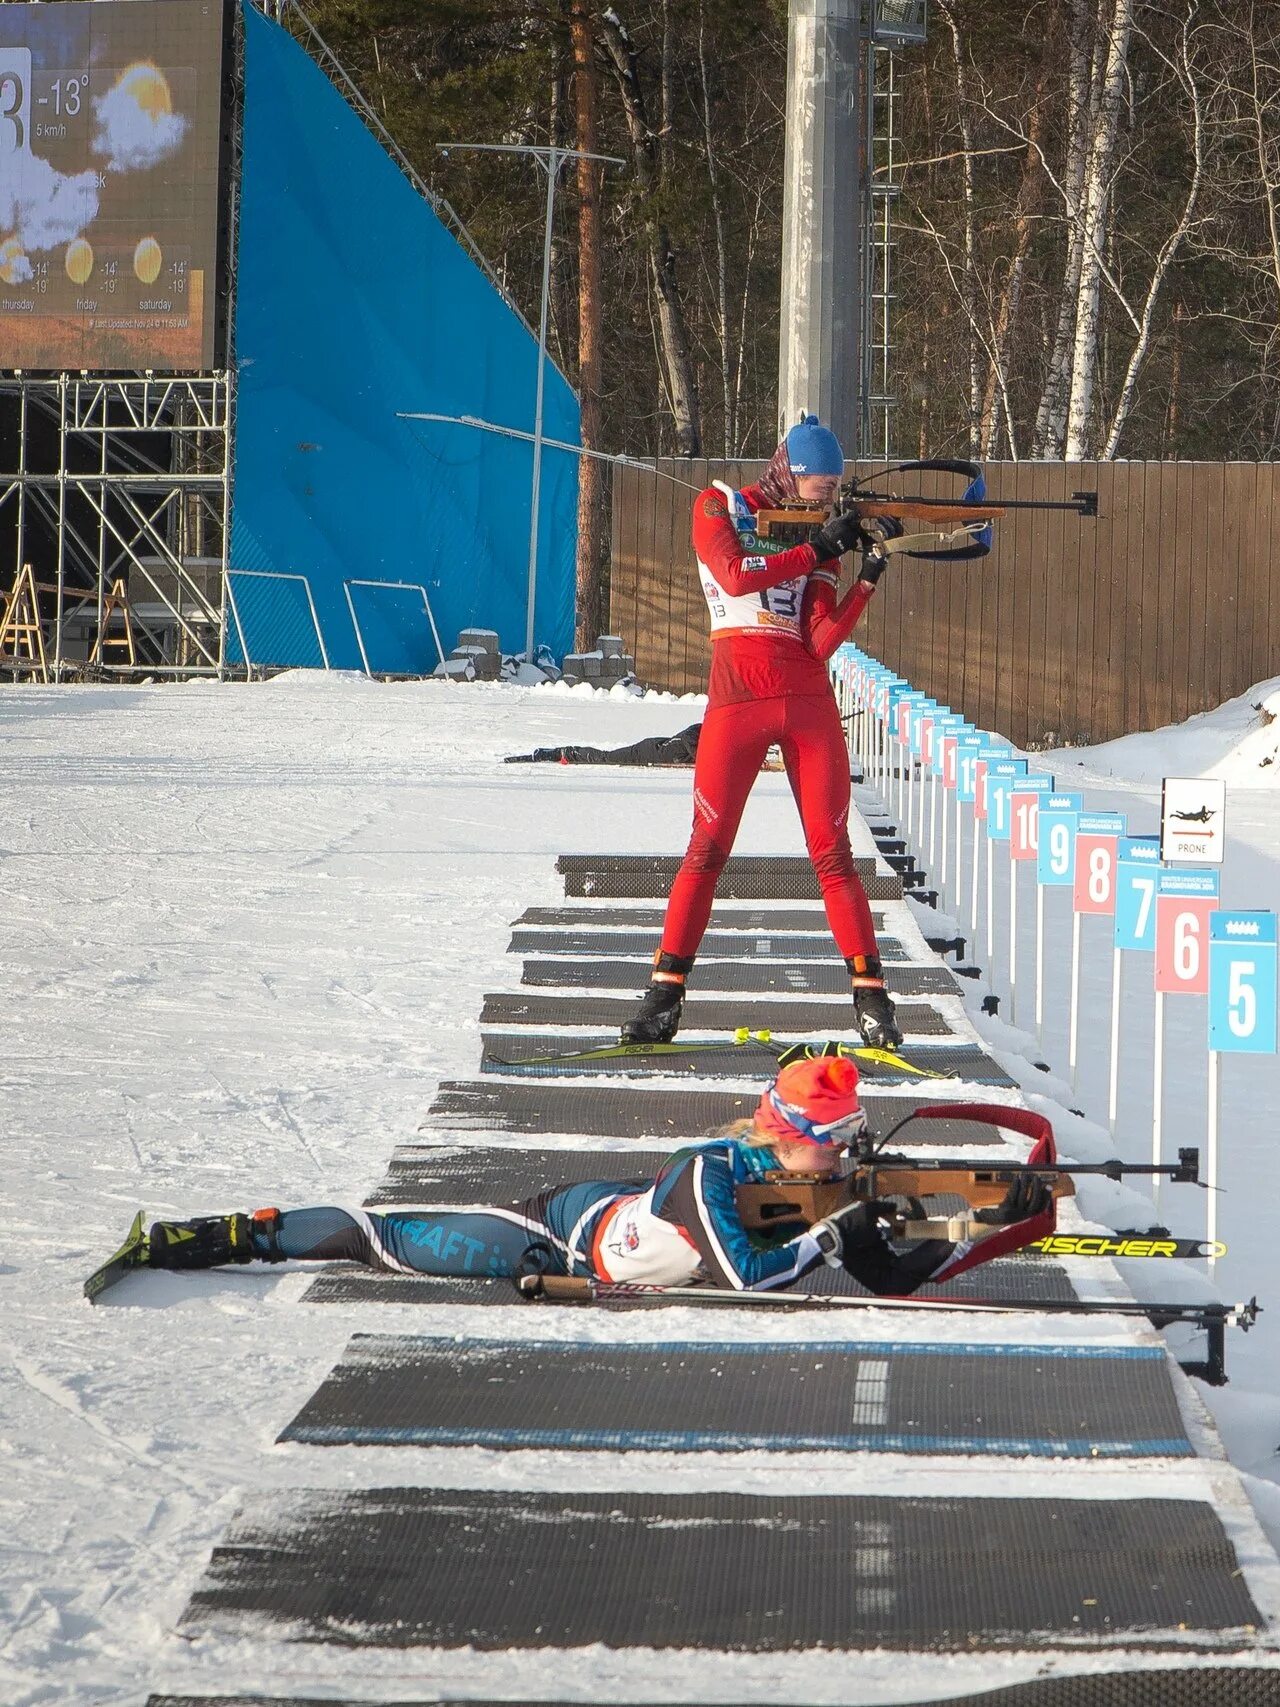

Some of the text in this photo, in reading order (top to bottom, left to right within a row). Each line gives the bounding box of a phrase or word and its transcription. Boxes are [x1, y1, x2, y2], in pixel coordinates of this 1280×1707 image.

[38, 74, 89, 115] -13°
[36, 123, 67, 136] 5 km/h
[76, 300, 98, 312] friday
[139, 300, 172, 312] saturday
[712, 604, 726, 618] 13
[1050, 824, 1069, 875] 9
[1178, 843, 1207, 854] PRONE
[1089, 847, 1111, 903] 8
[1131, 878, 1155, 938] 7
[1173, 911, 1200, 980] 6
[1228, 961, 1257, 1037] 5
